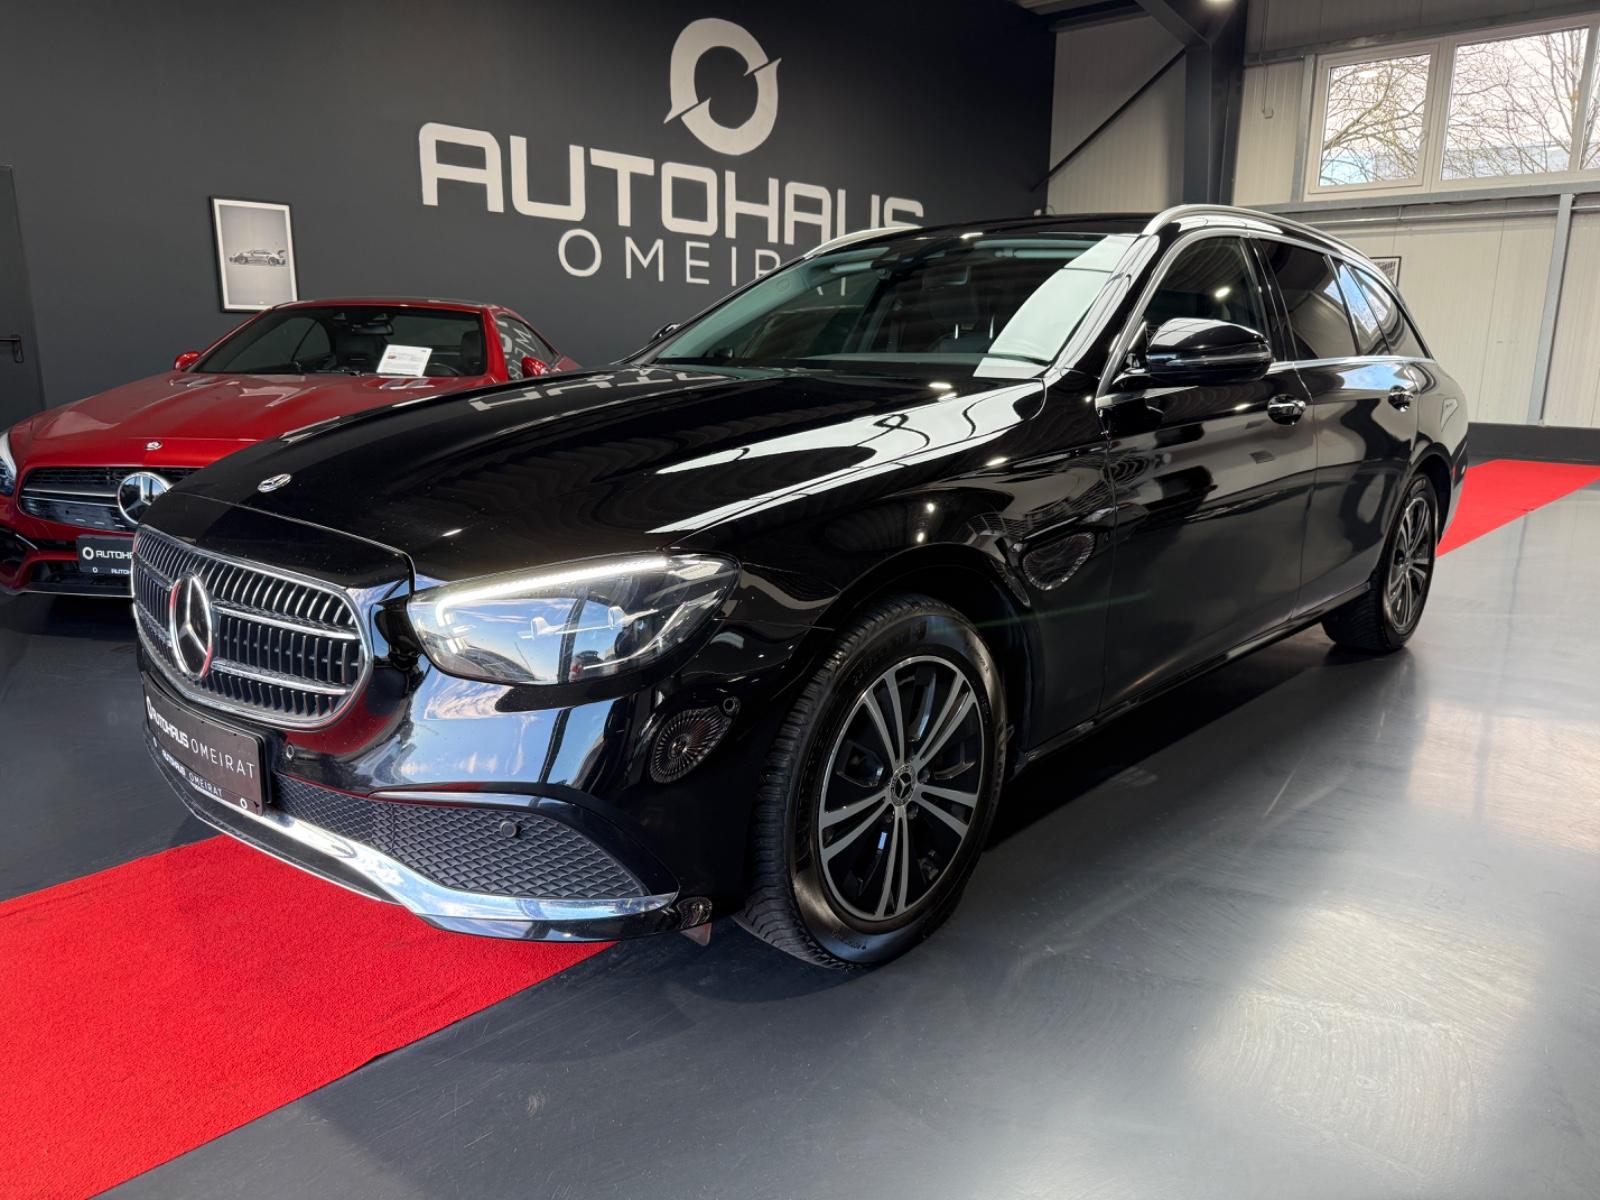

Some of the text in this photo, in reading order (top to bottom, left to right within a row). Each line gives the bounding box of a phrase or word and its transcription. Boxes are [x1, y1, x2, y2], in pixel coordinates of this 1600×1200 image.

[418, 122, 924, 248] AUTOHAUS
[558, 229, 846, 296] OMEIR
[190, 738, 256, 779] OMEIRAT
